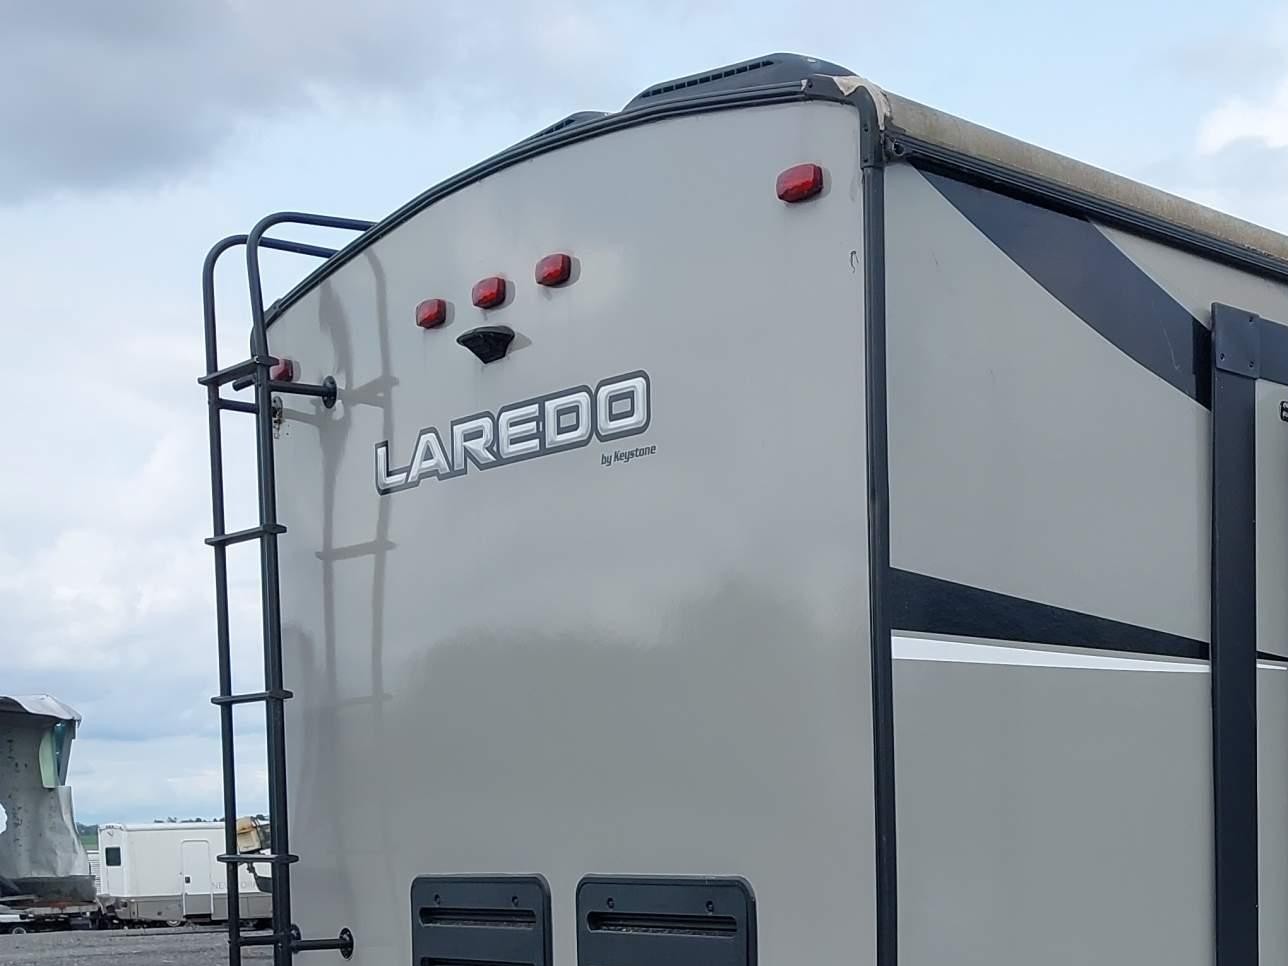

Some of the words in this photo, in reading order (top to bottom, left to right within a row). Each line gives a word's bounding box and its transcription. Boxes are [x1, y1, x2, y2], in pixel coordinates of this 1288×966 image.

[374, 369, 651, 496] LAREDO
[601, 454, 612, 466] by
[614, 445, 656, 463] Keystone
